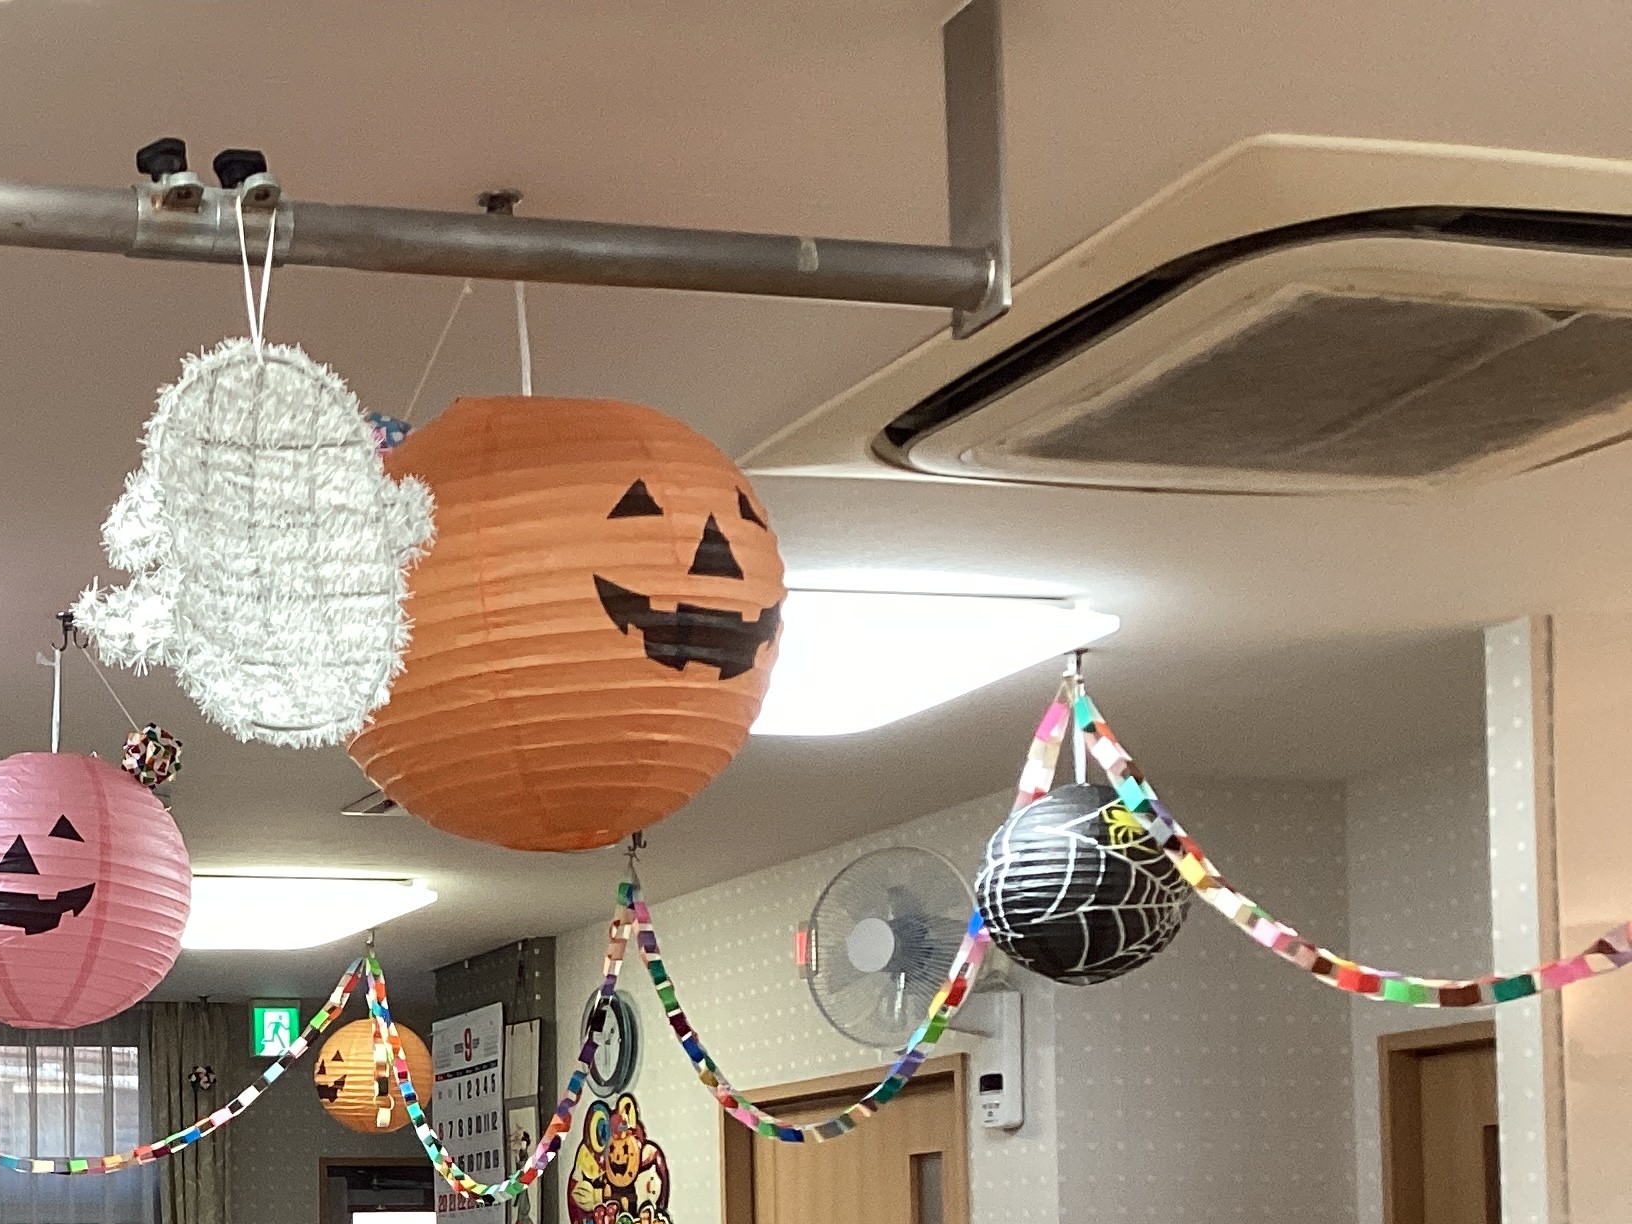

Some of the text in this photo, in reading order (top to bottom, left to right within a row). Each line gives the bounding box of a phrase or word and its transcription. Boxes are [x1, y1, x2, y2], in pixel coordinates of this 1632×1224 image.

[464, 1028, 472, 1062] 9
[466, 1080, 473, 1099] 2
[448, 1120, 454, 1139] 7
[458, 1118, 464, 1138] 8
[491, 1111, 498, 1131] 12
